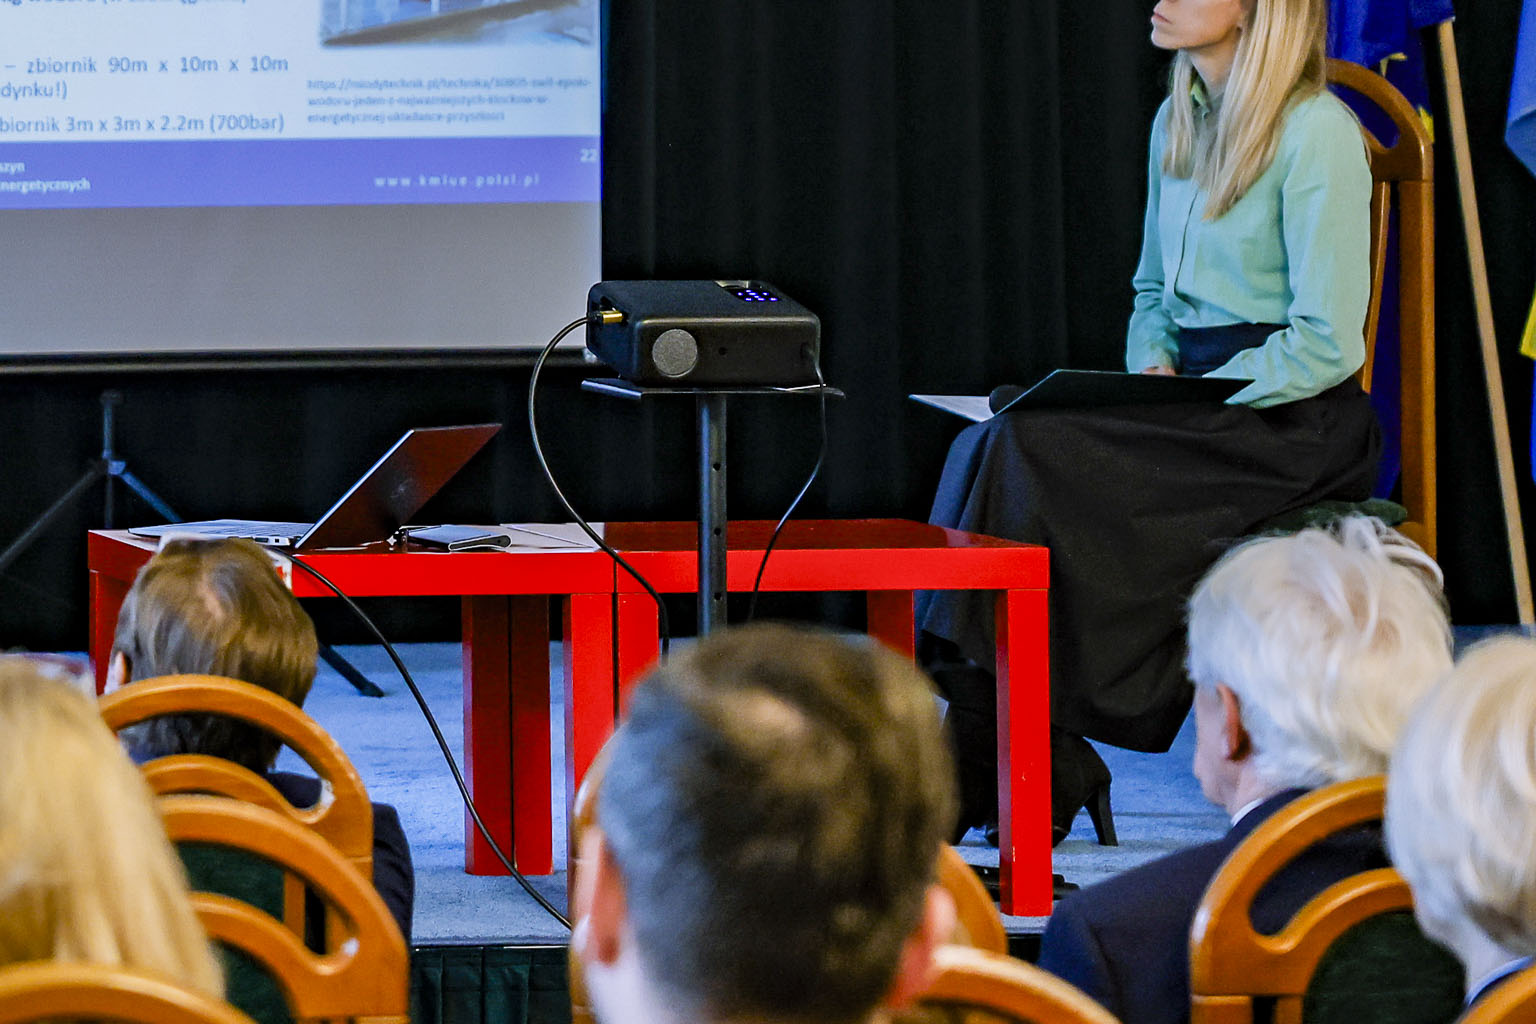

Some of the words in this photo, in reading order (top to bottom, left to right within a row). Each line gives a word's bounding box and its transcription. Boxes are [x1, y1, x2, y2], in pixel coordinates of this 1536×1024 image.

[27, 56, 98, 75] zbiornik
[108, 56, 148, 74] 90m
[180, 55, 219, 74] 10m
[250, 55, 289, 73] 10m
[65, 115, 94, 133] 3m
[113, 115, 141, 132] 3m
[160, 115, 205, 132] 2.2m
[209, 113, 285, 134] (700bar)
